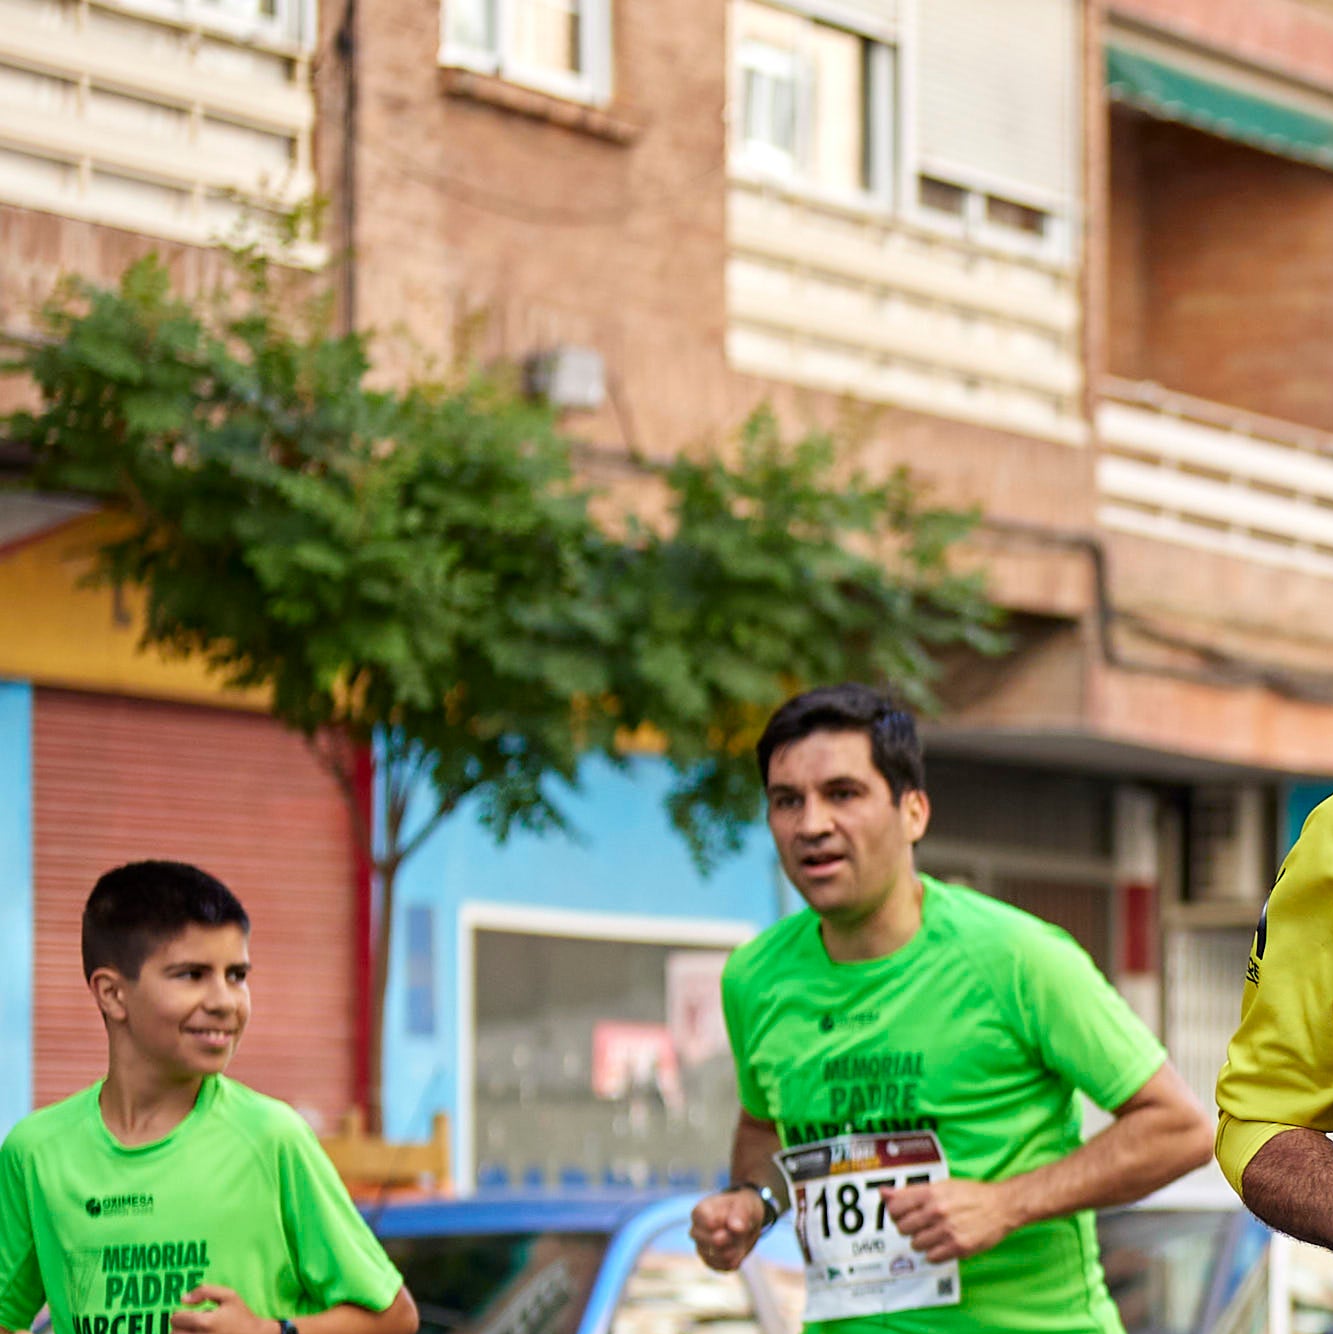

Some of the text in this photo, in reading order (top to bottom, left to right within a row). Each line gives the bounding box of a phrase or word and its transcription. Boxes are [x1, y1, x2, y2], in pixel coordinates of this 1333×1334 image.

[823, 1052, 923, 1081] MEMORIAL
[829, 1083, 918, 1117] PADRE
[102, 1240, 210, 1272] MEMORIAL
